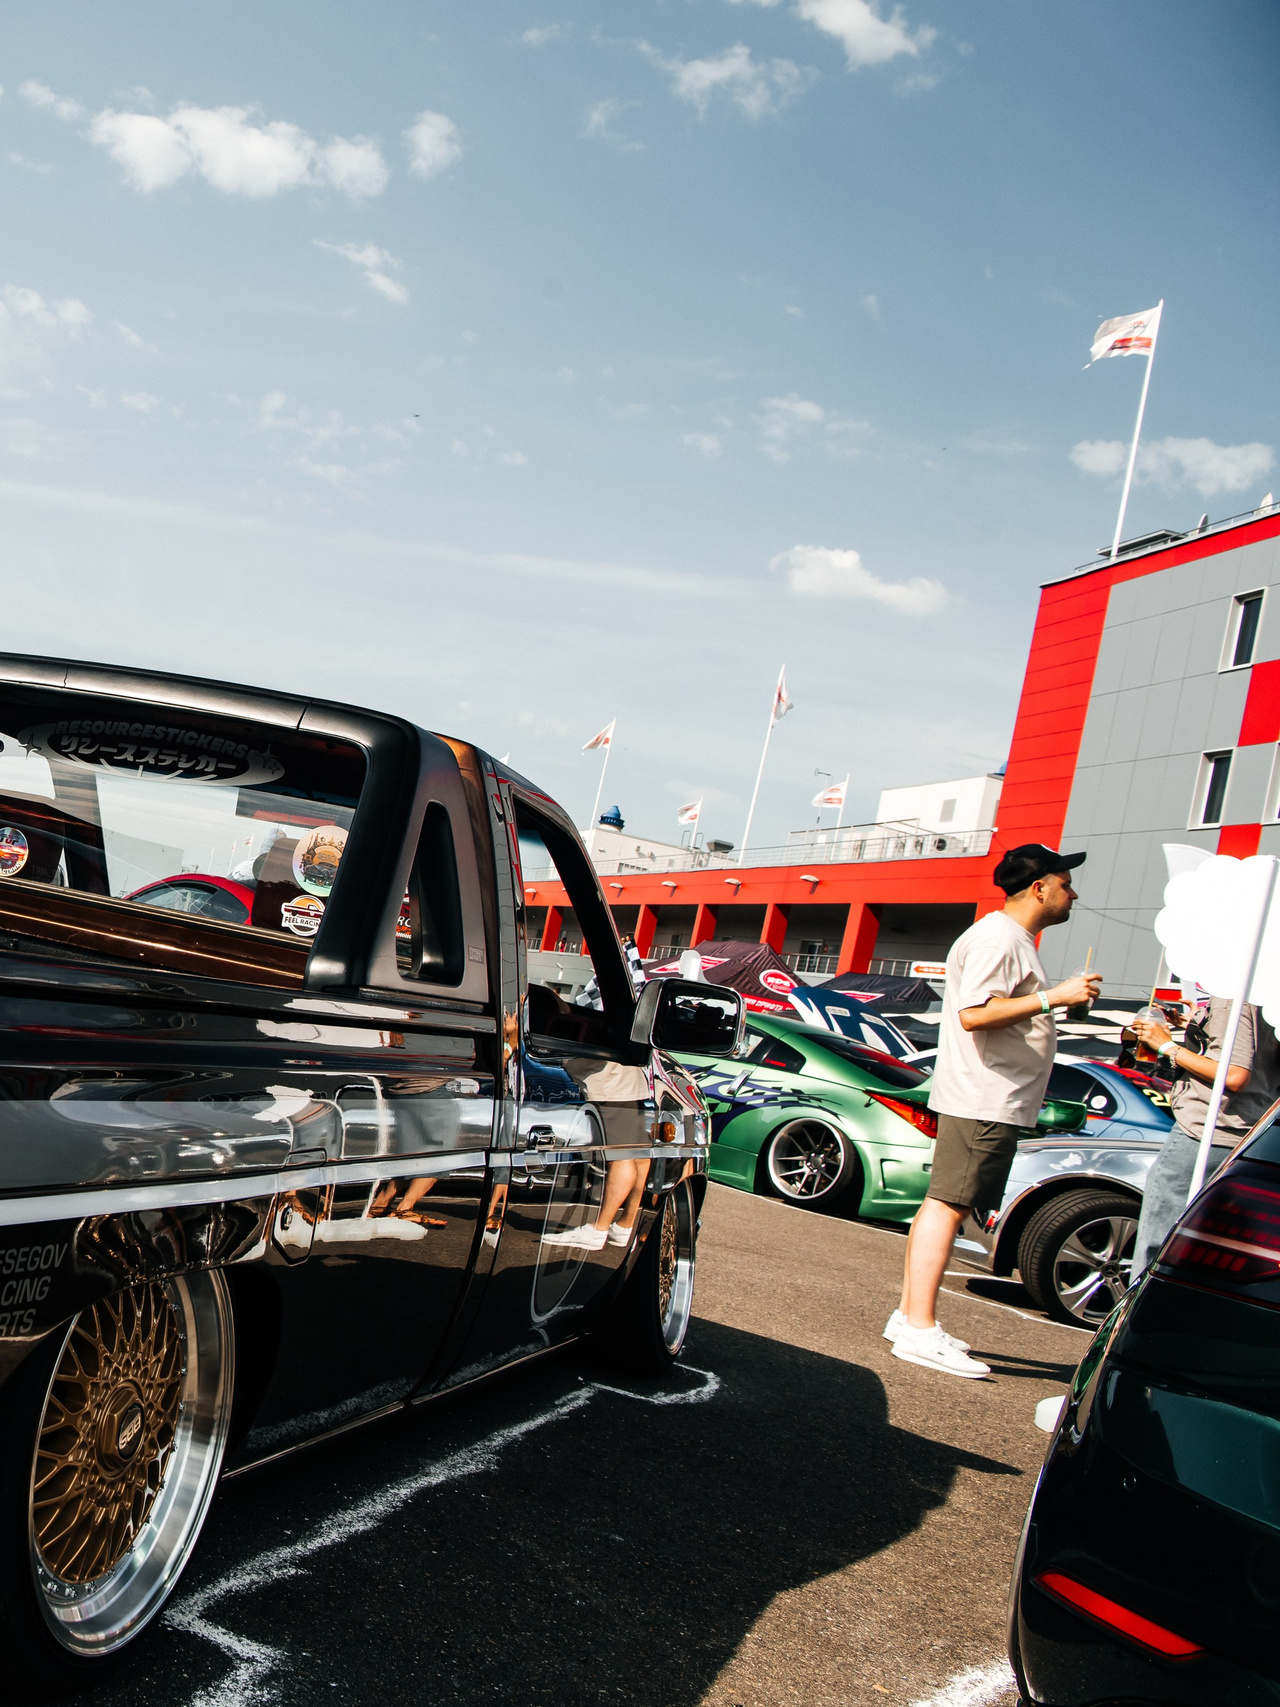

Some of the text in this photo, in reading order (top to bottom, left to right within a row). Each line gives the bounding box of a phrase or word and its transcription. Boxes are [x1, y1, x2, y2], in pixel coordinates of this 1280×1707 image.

[55, 720, 249, 759] RESOURCESTICKERS
[284, 916, 320, 927] FEEL RACIN
